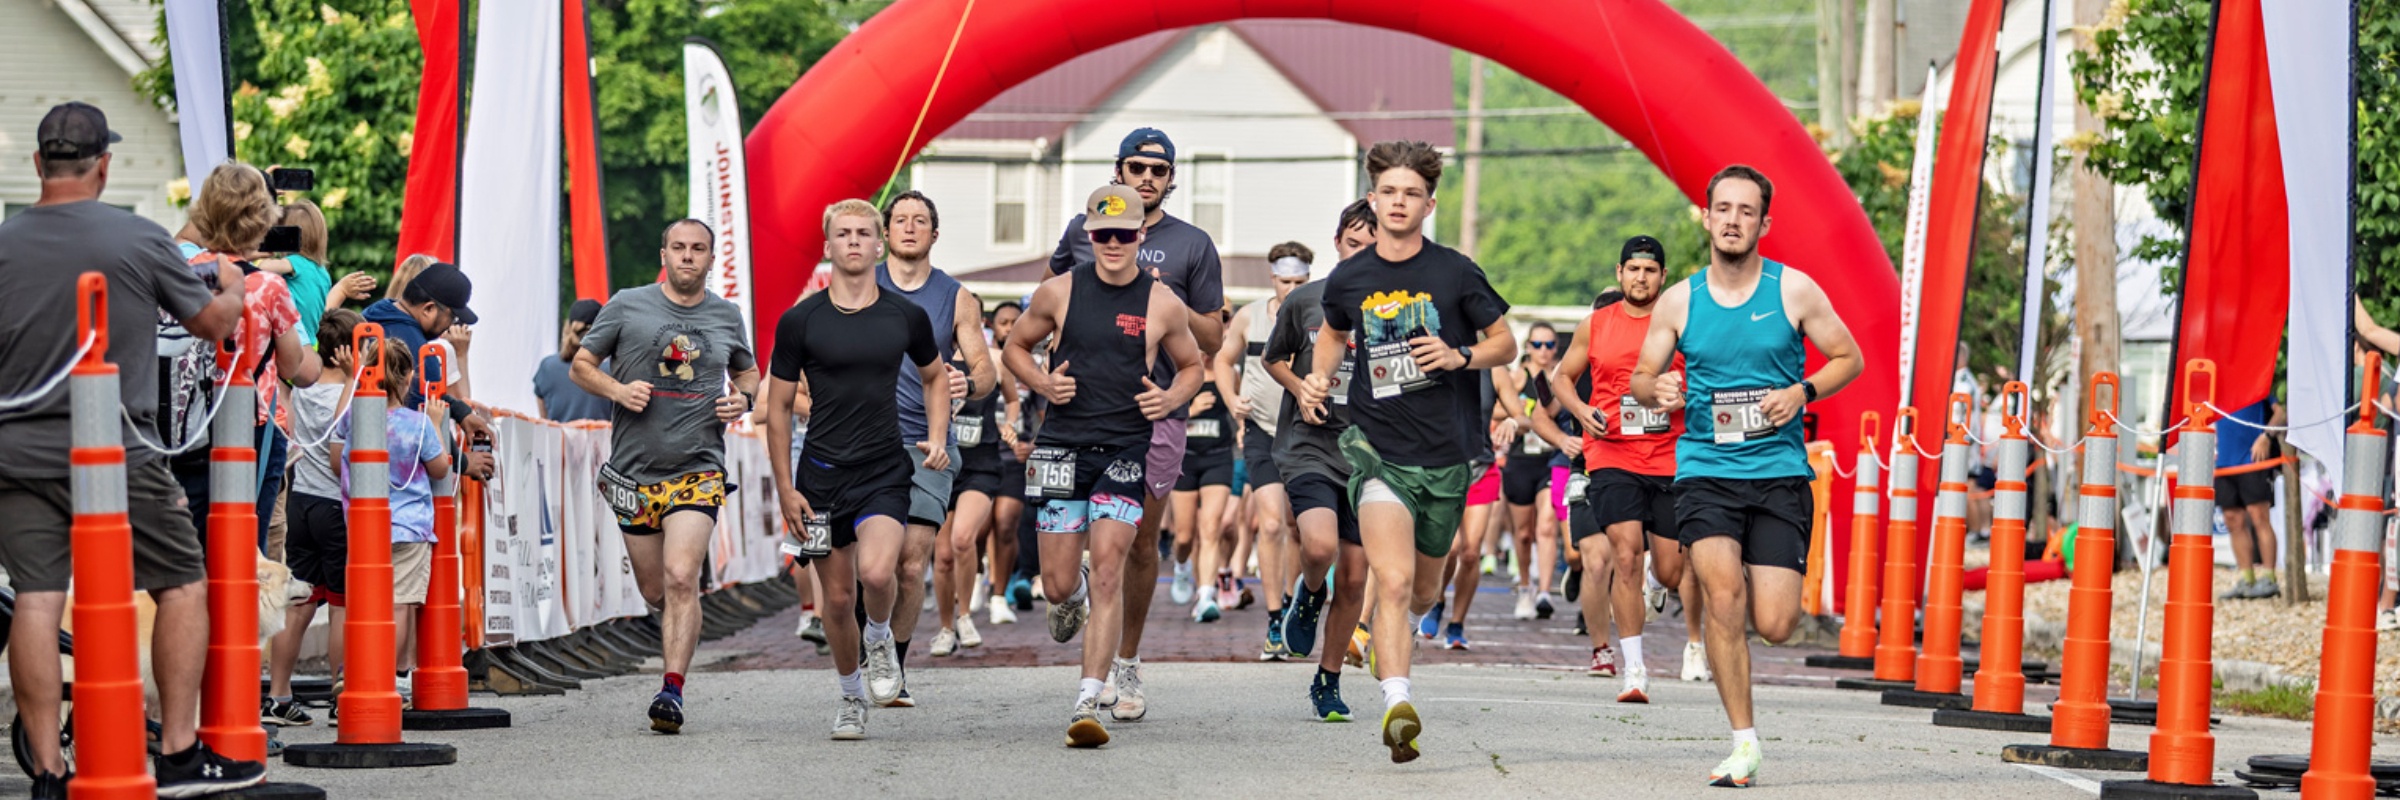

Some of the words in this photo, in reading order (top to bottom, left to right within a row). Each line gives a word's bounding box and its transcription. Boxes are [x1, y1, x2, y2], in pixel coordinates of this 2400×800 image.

[716, 141, 739, 299] JOHNSTOWN
[1390, 355, 1426, 383] 20
[956, 425, 979, 443] 167
[1041, 462, 1071, 487] 156
[610, 484, 636, 511] 190
[804, 526, 828, 550] 52
